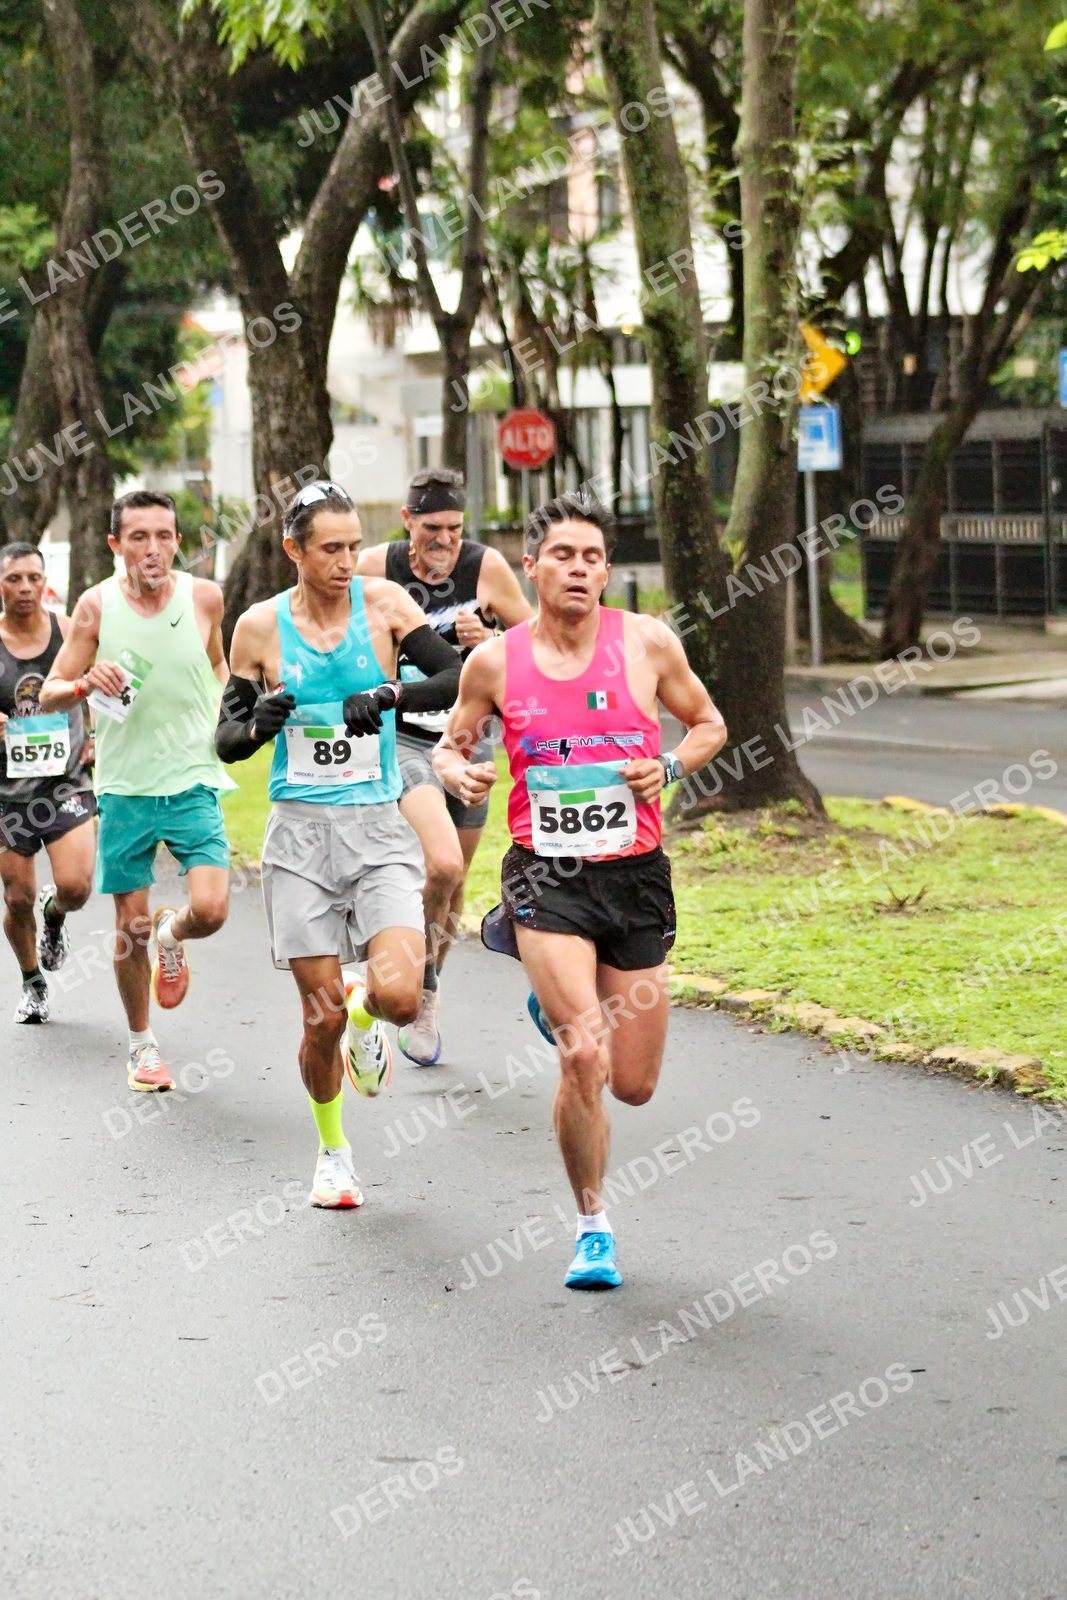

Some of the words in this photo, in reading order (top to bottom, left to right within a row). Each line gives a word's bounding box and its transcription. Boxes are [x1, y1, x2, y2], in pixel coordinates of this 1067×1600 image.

[503, 427, 553, 451] ALTO
[11, 742, 66, 763] 6578
[313, 739, 352, 766] 89
[539, 801, 628, 834] 5862
